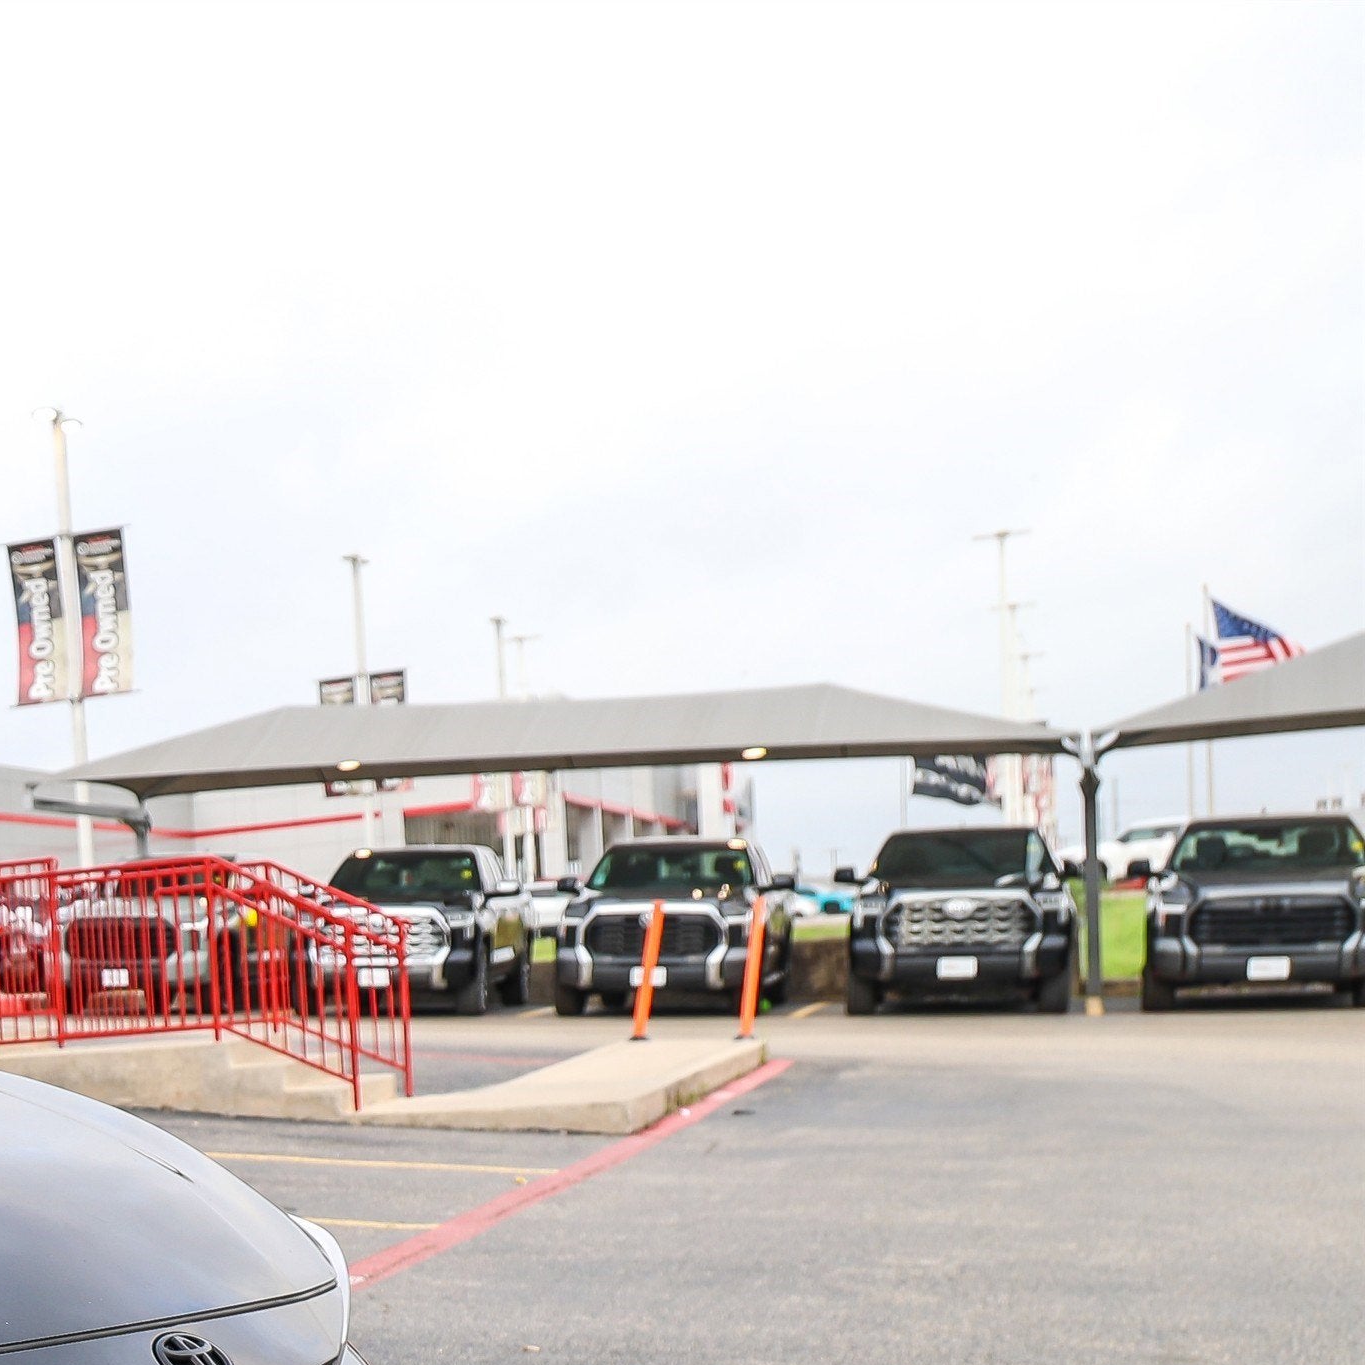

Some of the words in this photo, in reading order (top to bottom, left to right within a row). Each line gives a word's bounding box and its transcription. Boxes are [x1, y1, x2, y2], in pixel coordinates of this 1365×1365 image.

[23, 576, 55, 660] Owned
[88, 568, 120, 652] Owned
[27, 659, 56, 699] Pre
[92, 652, 120, 694] Pre
